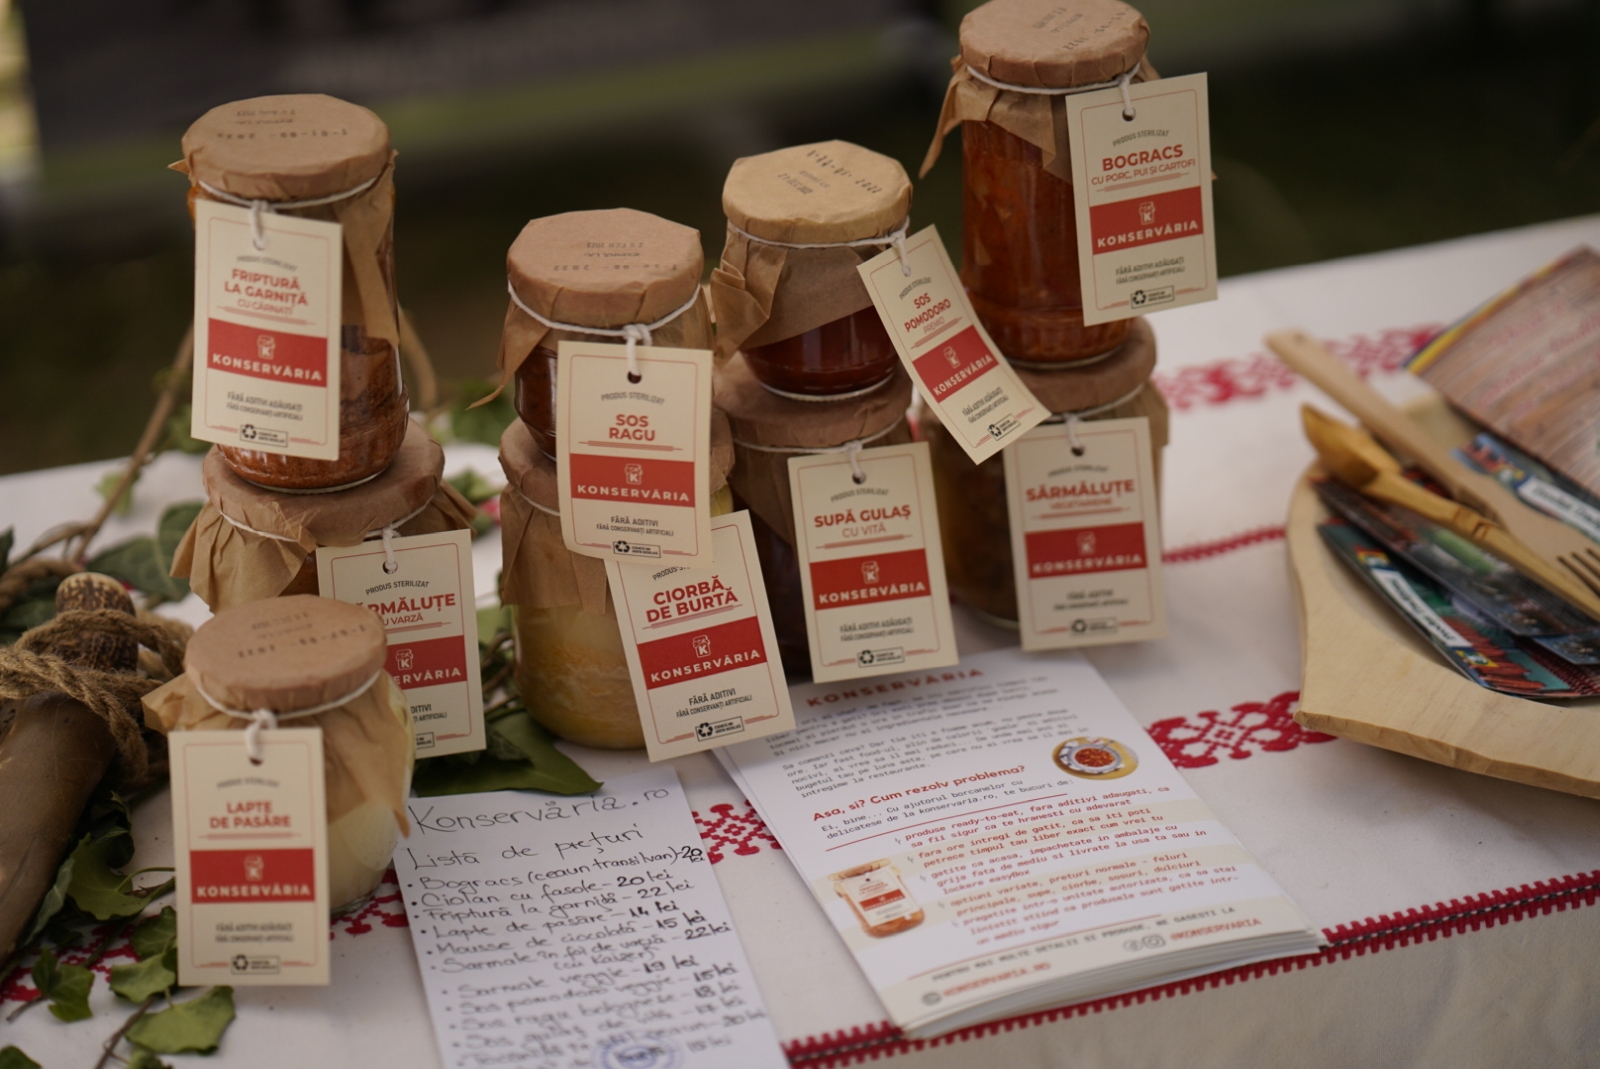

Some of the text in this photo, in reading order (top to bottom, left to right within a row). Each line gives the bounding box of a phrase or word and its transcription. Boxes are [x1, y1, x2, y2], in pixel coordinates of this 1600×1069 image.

[1112, 129, 1169, 147] PRODUS STERILIZAT
[1102, 144, 1183, 172] BOGRACS
[1091, 176, 1104, 186] CU
[1105, 171, 1133, 183] PORC,
[1134, 168, 1148, 177] PUI
[1158, 158, 1196, 173] CARTOFI
[224, 281, 240, 294] LA
[232, 268, 300, 290] FRIPTURĂ
[913, 292, 931, 310] SOS
[904, 298, 951, 333] POMODORO
[601, 392, 627, 402] PRODUS
[616, 414, 649, 428] SOS
[609, 427, 655, 441] RAGU
[577, 485, 689, 502] KONSERVĂRIA
[611, 516, 659, 527] FĂRĂ ADITIVI
[814, 504, 912, 528] SUPĂ GULAȘ
[646, 528, 674, 537] ARTIFICIALI
[842, 522, 887, 538] CU VITĂ
[365, 580, 430, 596] PRODUS STERILIZAT
[653, 575, 725, 605] CIORBĂ
[356, 593, 456, 615] RMĂLUȚE
[646, 586, 738, 623] DE BURTĂ
[391, 612, 424, 625] VARZĂ
[393, 667, 461, 684] ERVĂRIA
[651, 649, 761, 683] KONSERVĂRIA
[676, 709, 690, 718] FĂRĂ
[725, 694, 753, 706] ARTIFICIALI
[688, 688, 736, 706] FĂRĂ ADITIVI
[411, 704, 431, 714] DITIVI
[813, 765, 1026, 821] Asa, si? Cum rezolv problema?
[886, 806, 899, 814] Cu
[903, 794, 948, 810] ajutorul
[951, 782, 1005, 798] borcanelor
[226, 801, 272, 814] LAPTE
[826, 819, 883, 840] delicatese
[886, 815, 899, 823] de
[1019, 782, 1053, 793] bucuri
[905, 825, 946, 841] produse
[951, 809, 1024, 829] ready-to-eat,
[1030, 803, 1053, 812] fara
[1058, 795, 1098, 808] aditivi
[1102, 788, 1152, 800] adaugati,
[210, 817, 229, 829] DE
[911, 841, 923, 849] sa
[928, 835, 946, 843] fii
[951, 827, 979, 838] sigur
[1018, 810, 1064, 824] hranesti
[1086, 800, 1132, 811] adevarat
[918, 848, 942, 859] fara
[946, 843, 965, 851] ore
[970, 832, 1010, 847] intregi
[1015, 828, 1027, 836] de
[1032, 823, 1066, 834] gatit,
[1106, 811, 1123, 819] iti
[1128, 808, 1151, 817] poti
[502, 846, 538, 859] de
[923, 853, 965, 868] petrece
[970, 843, 1005, 855] timpul
[1010, 838, 1028, 846] tau
[1033, 832, 1061, 842] liber
[1066, 825, 1096, 835] exact
[1123, 816, 1147, 825] vrei
[931, 864, 966, 879] gatite
[989, 853, 1023, 864] acasa,
[1029, 836, 1093, 855] impachetate
[1114, 826, 1160, 839] ambalaje
[936, 831, 1190, 888] grija fata de mediu livrate usa sau
[1095, 861, 1137, 874] normale
[1152, 852, 1188, 863] feluri
[1154, 860, 1201, 873] dulciuri
[420, 876, 523, 895] Bogracs
[527, 865, 590, 881] (ceaun
[421, 869, 674, 907] Ciolan cu fasole 20 lei
[521, 903, 543, 914] la
[637, 886, 667, 899] 22
[666, 879, 695, 894] lei
[433, 925, 496, 942] Lapte
[506, 921, 538, 934] de
[655, 900, 680, 913] lei
[436, 942, 515, 955] Mousse
[526, 937, 552, 948] de
[656, 917, 678, 929] 15
[682, 910, 707, 926] lei
[441, 922, 733, 973] Sarmale 22 lei
[643, 961, 666, 974] 19
[672, 955, 699, 969] lei
